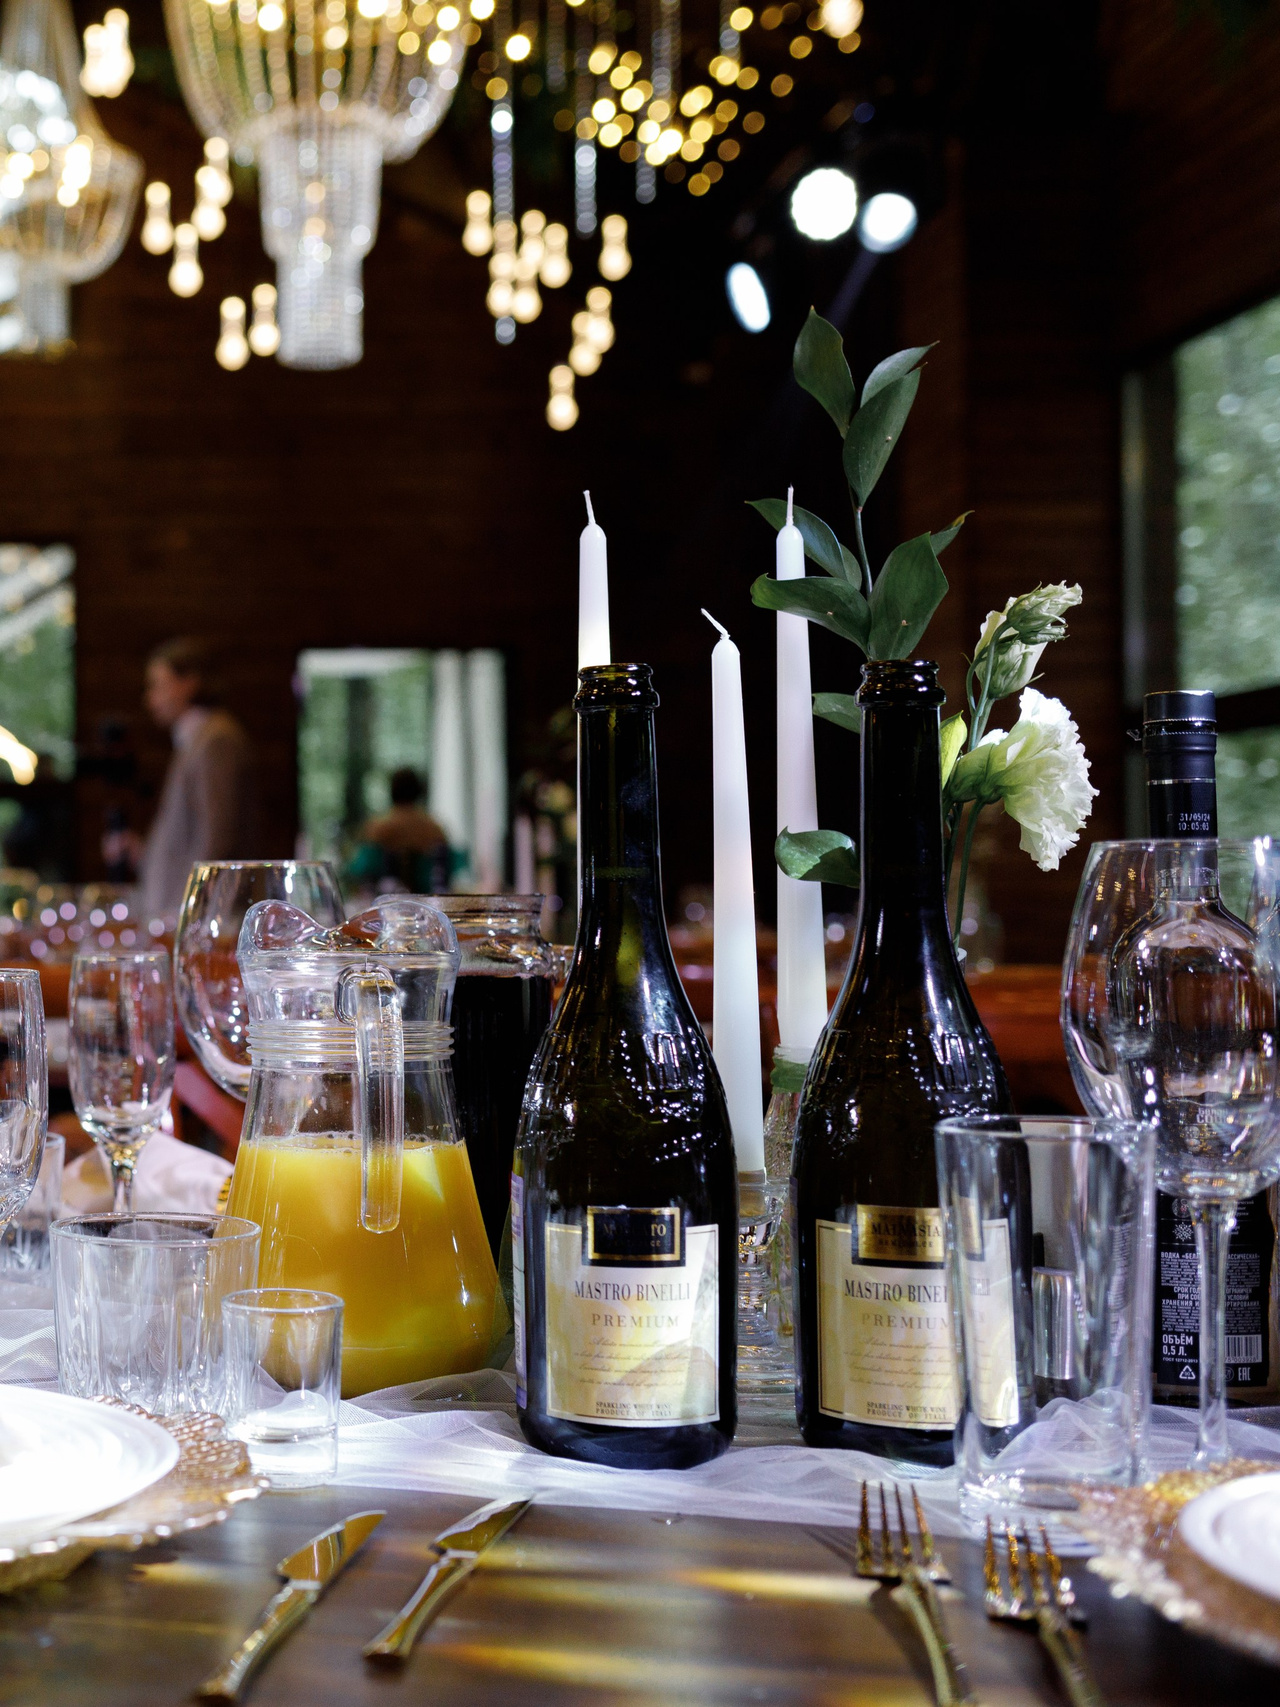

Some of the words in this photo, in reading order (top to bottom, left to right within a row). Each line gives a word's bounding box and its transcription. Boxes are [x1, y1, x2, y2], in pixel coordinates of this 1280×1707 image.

[1180, 813, 1210, 821] 31/05/24
[1178, 822, 1209, 830] 10:05:03
[1160, 1251, 1180, 1259] ВОДКА
[574, 1280, 631, 1301] MASTRO
[636, 1283, 690, 1301] BINELLI
[844, 1278, 902, 1302] MASTRO
[1162, 1299, 1193, 1307] ХРАНЕНИЯ
[591, 1313, 678, 1328] PREMIUM
[1162, 1333, 1193, 1345] ОБЪЁМ
[1162, 1345, 1176, 1356] 0,5
[1178, 1346, 1187, 1356] Л.
[595, 1401, 632, 1409] SPARKLING
[867, 1401, 903, 1411] SPARKLING
[867, 1408, 902, 1418] PRODUCT
